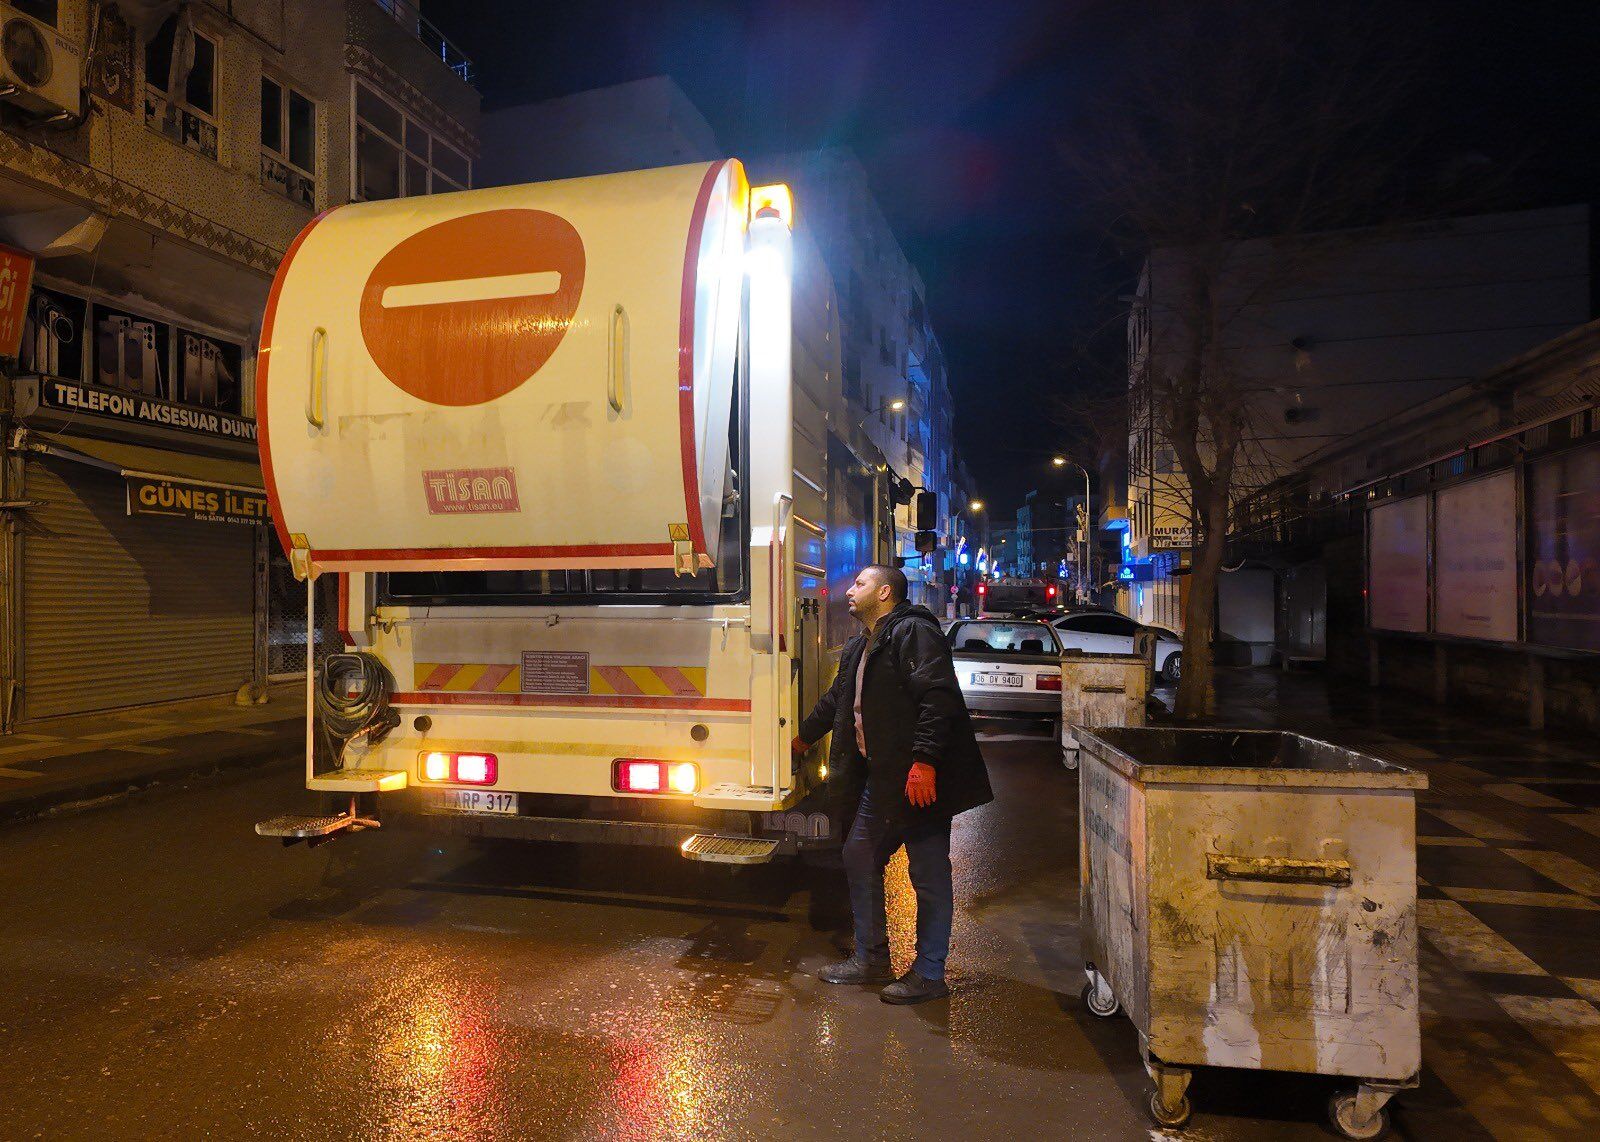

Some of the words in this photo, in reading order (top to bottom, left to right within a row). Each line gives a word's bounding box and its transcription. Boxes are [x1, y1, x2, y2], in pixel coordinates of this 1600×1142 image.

[55, 383, 135, 416] TELEFON
[139, 401, 219, 433] AKSESUAR
[139, 482, 220, 515] GÜNEŞ
[429, 473, 512, 501] TİSAN
[443, 502, 503, 512] www.tisan.eu
[1002, 676, 1020, 684] 9400
[455, 792, 480, 809] ARP
[486, 794, 513, 812] 317
